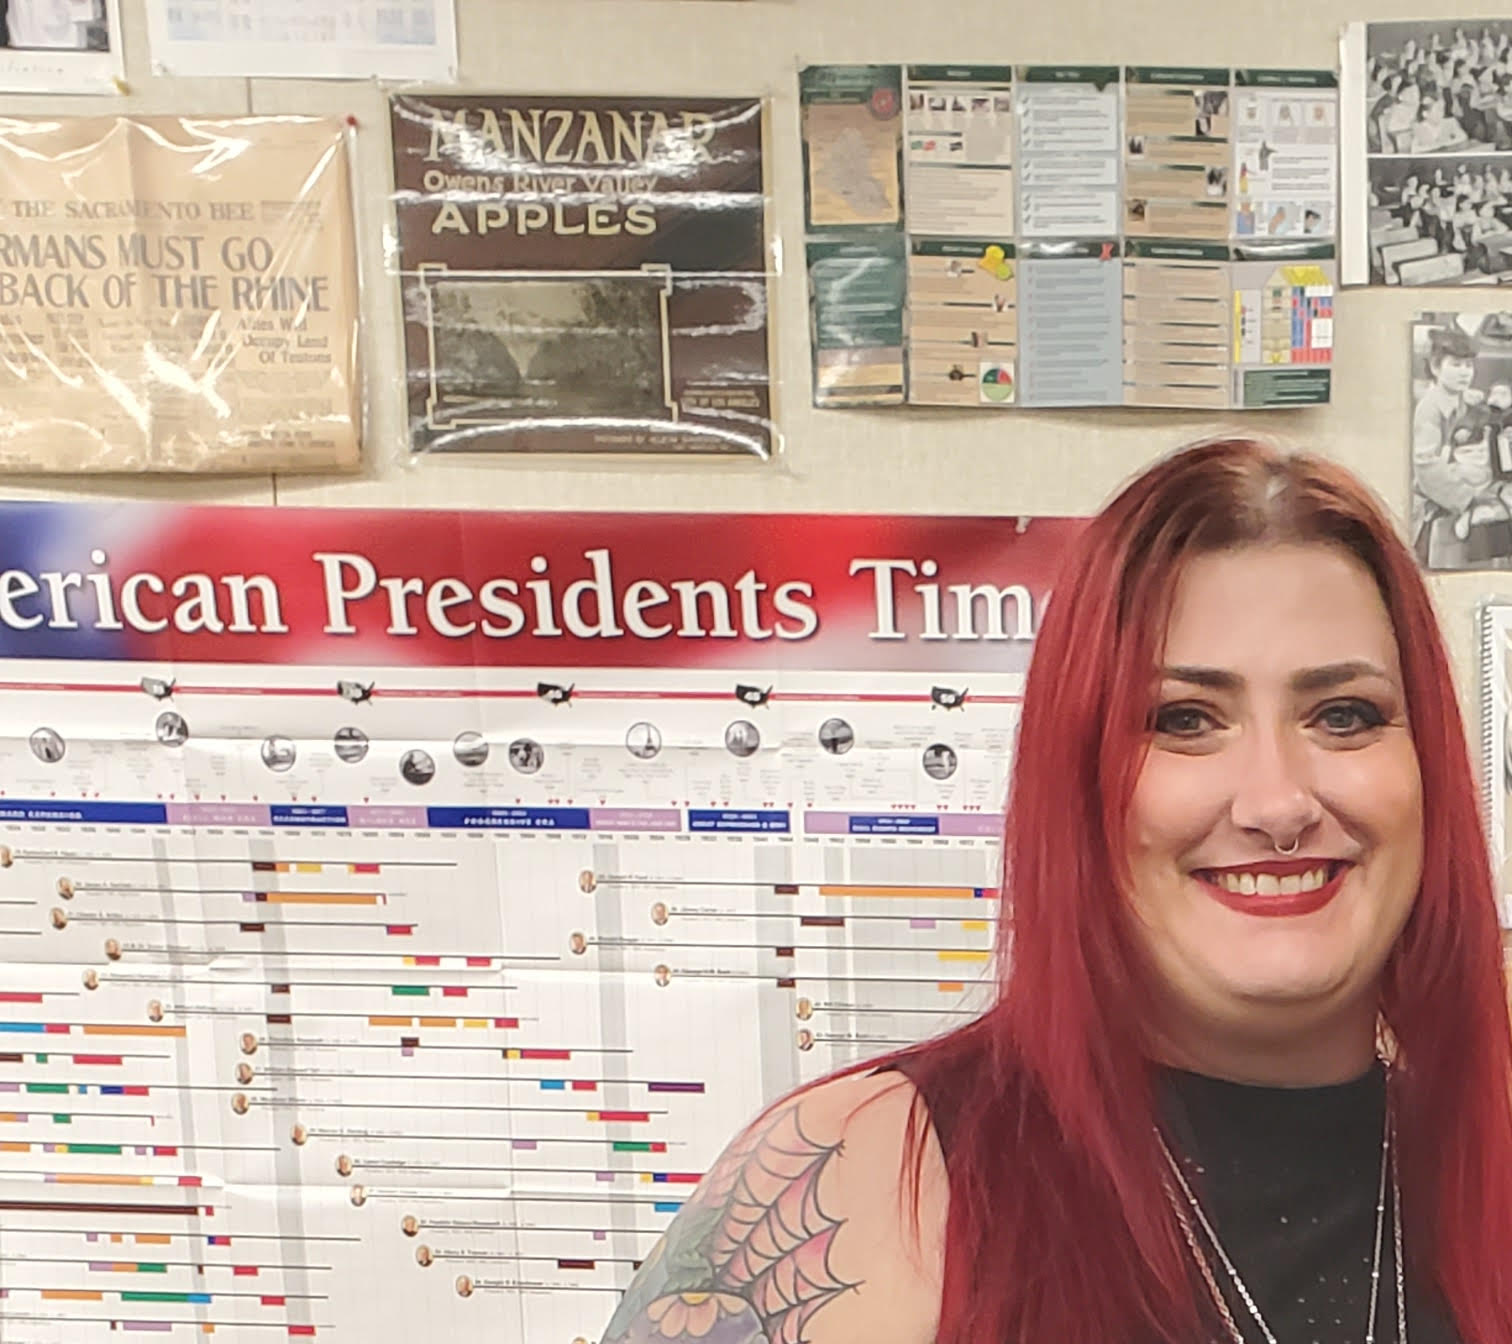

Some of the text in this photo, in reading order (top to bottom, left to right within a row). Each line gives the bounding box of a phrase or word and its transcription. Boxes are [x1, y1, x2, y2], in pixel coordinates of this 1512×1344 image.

[422, 107, 716, 165] MANZANAR
[423, 170, 658, 194] Owens River Valley
[13, 200, 54, 218] THE
[209, 202, 255, 221] BEE
[431, 203, 657, 236] APPLES
[117, 232, 204, 271] MUST
[221, 236, 274, 272] GO
[0, 272, 90, 309] BACK
[152, 274, 218, 310] THE
[231, 275, 330, 312] RHINE
[313, 548, 819, 641] Presidents
[850, 556, 1053, 643] Tim
